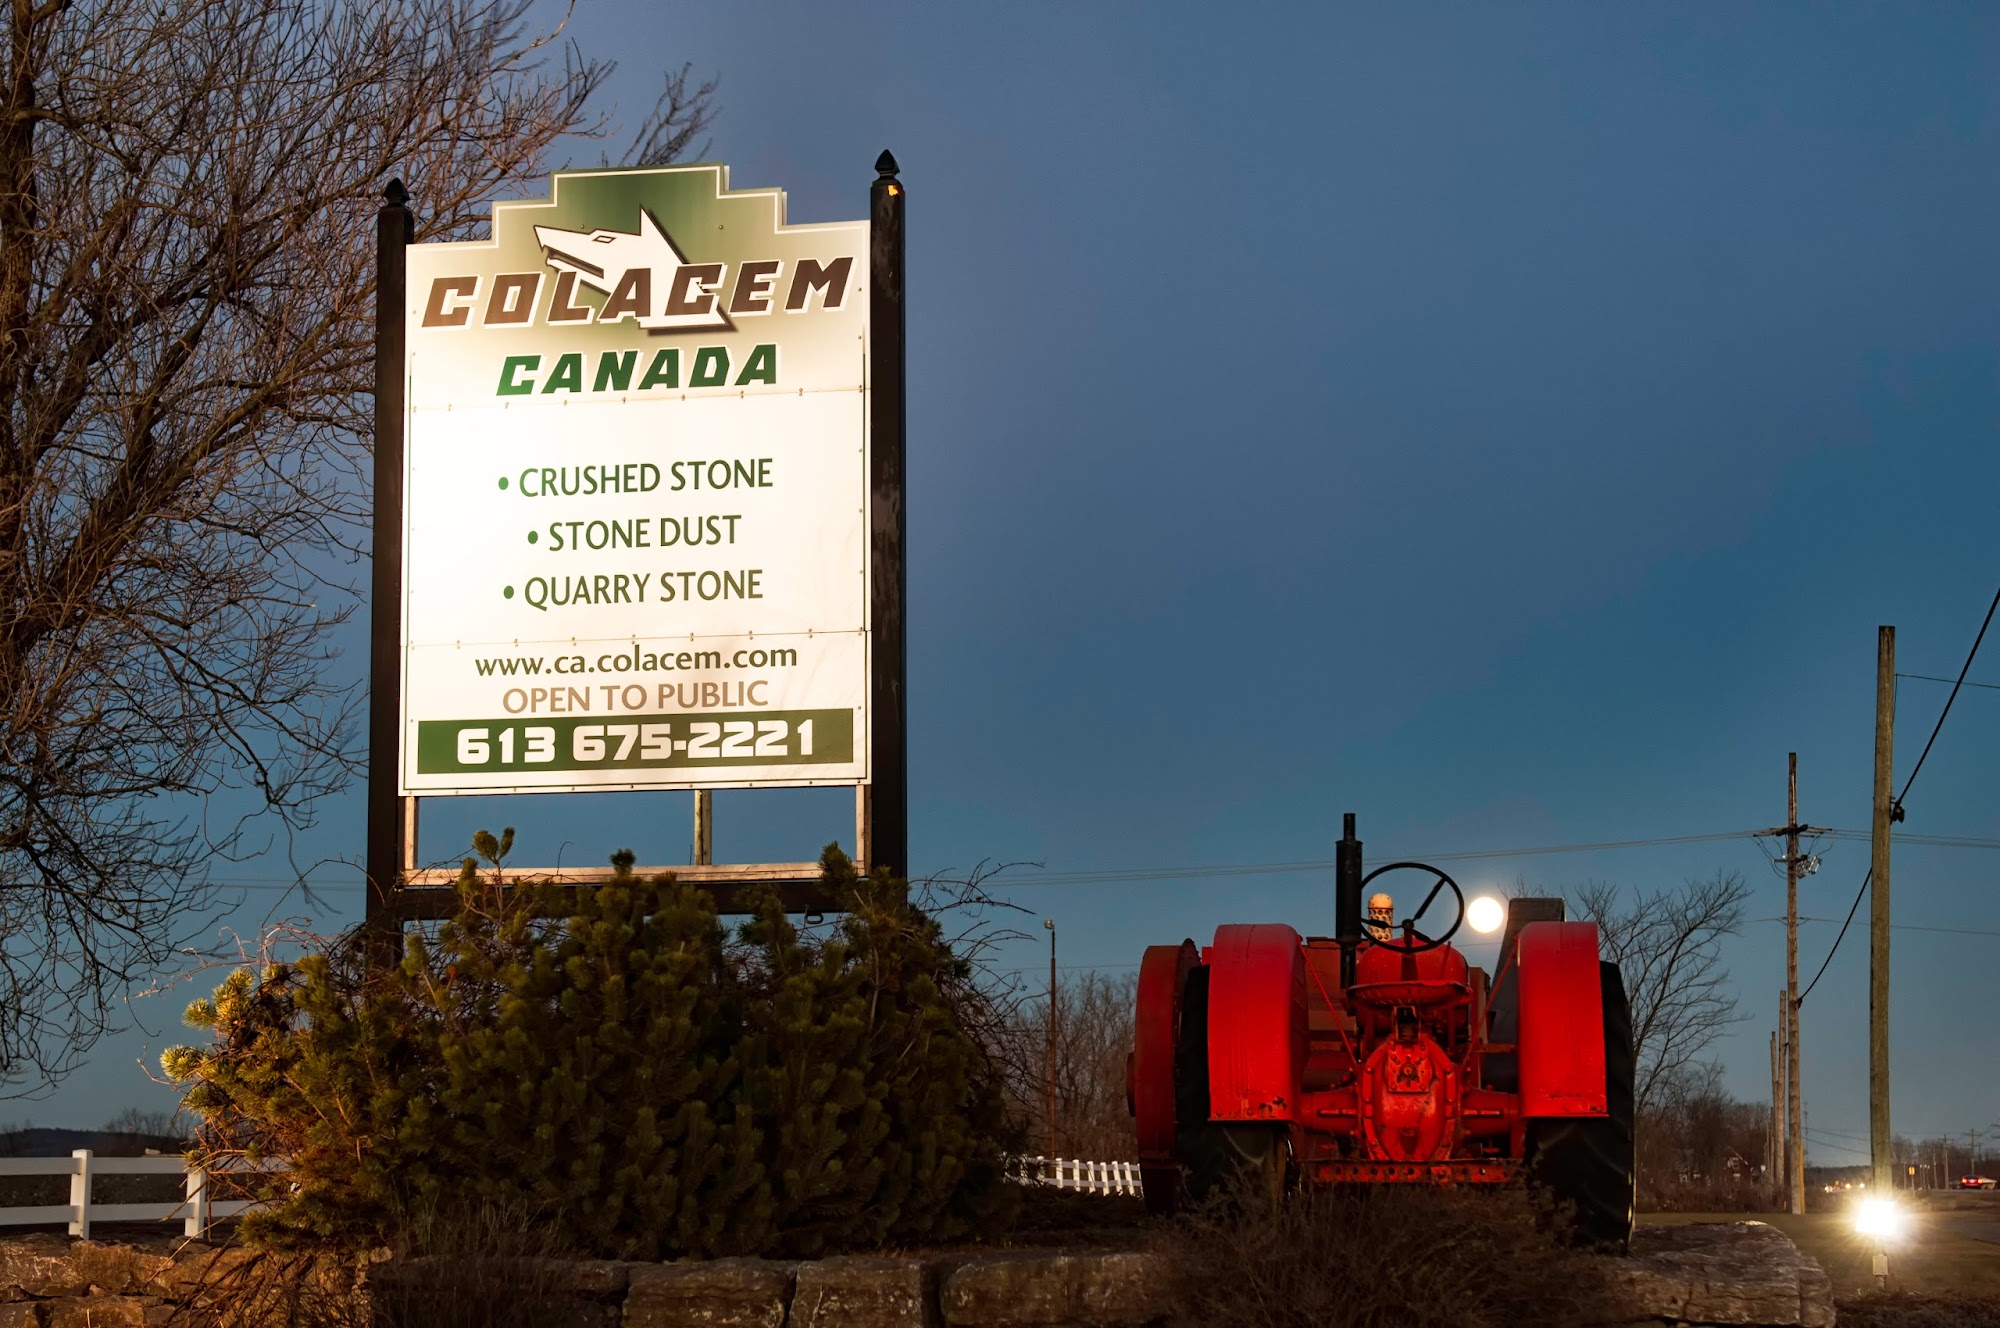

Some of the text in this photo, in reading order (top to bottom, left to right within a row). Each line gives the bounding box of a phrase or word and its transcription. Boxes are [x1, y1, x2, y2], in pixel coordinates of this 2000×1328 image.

[421, 256, 855, 328] COLACEM
[496, 343, 777, 396] CANADA
[519, 458, 774, 497] CRUSHED STONE
[548, 514, 742, 551] STONE DUST
[524, 569, 764, 612] QUARRY STONE
[475, 644, 798, 677] www.ca.colacem.com
[502, 680, 768, 714] OPEN TO PUBLIC
[457, 718, 814, 764] 613 675-2221
